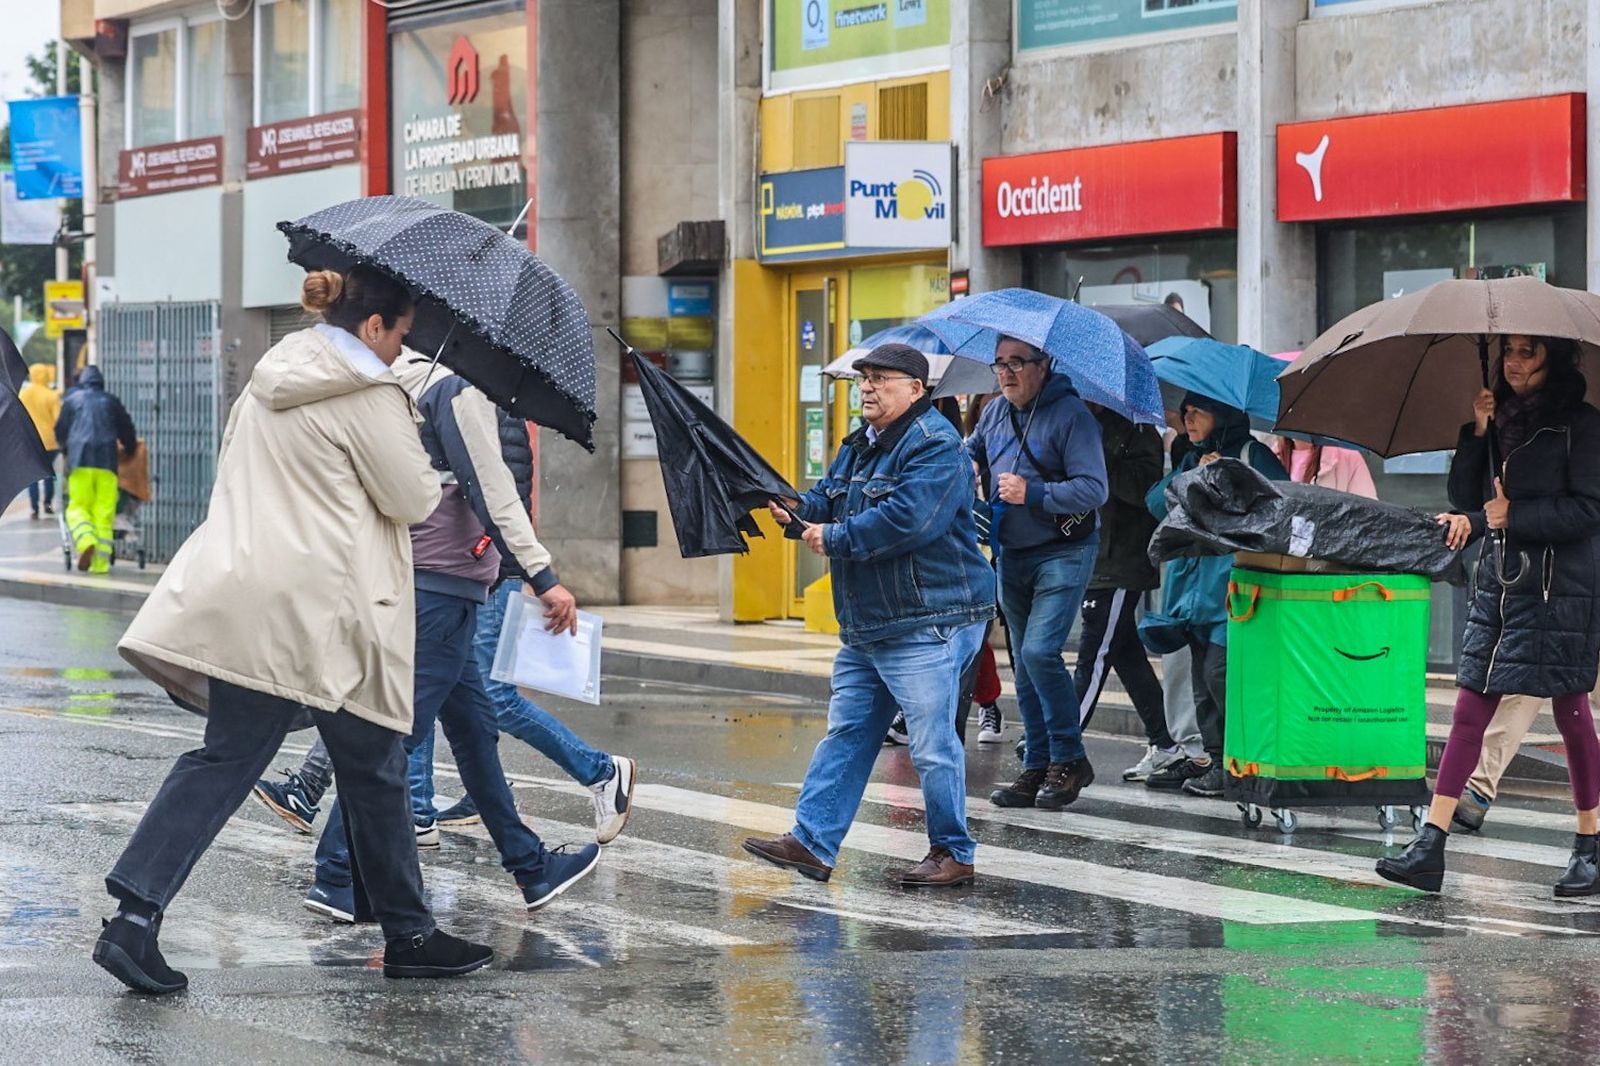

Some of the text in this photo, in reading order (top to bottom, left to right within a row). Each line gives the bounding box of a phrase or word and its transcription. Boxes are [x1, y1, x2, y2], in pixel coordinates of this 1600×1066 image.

[404, 113, 461, 144] CÁMARA DE
[404, 133, 520, 171] LA PROPIEDAD URBANA
[405, 161, 521, 197] DE HUELVA Y PROVINCIA
[997, 176, 1082, 218] Occident
[1313, 705, 1341, 715] Property
